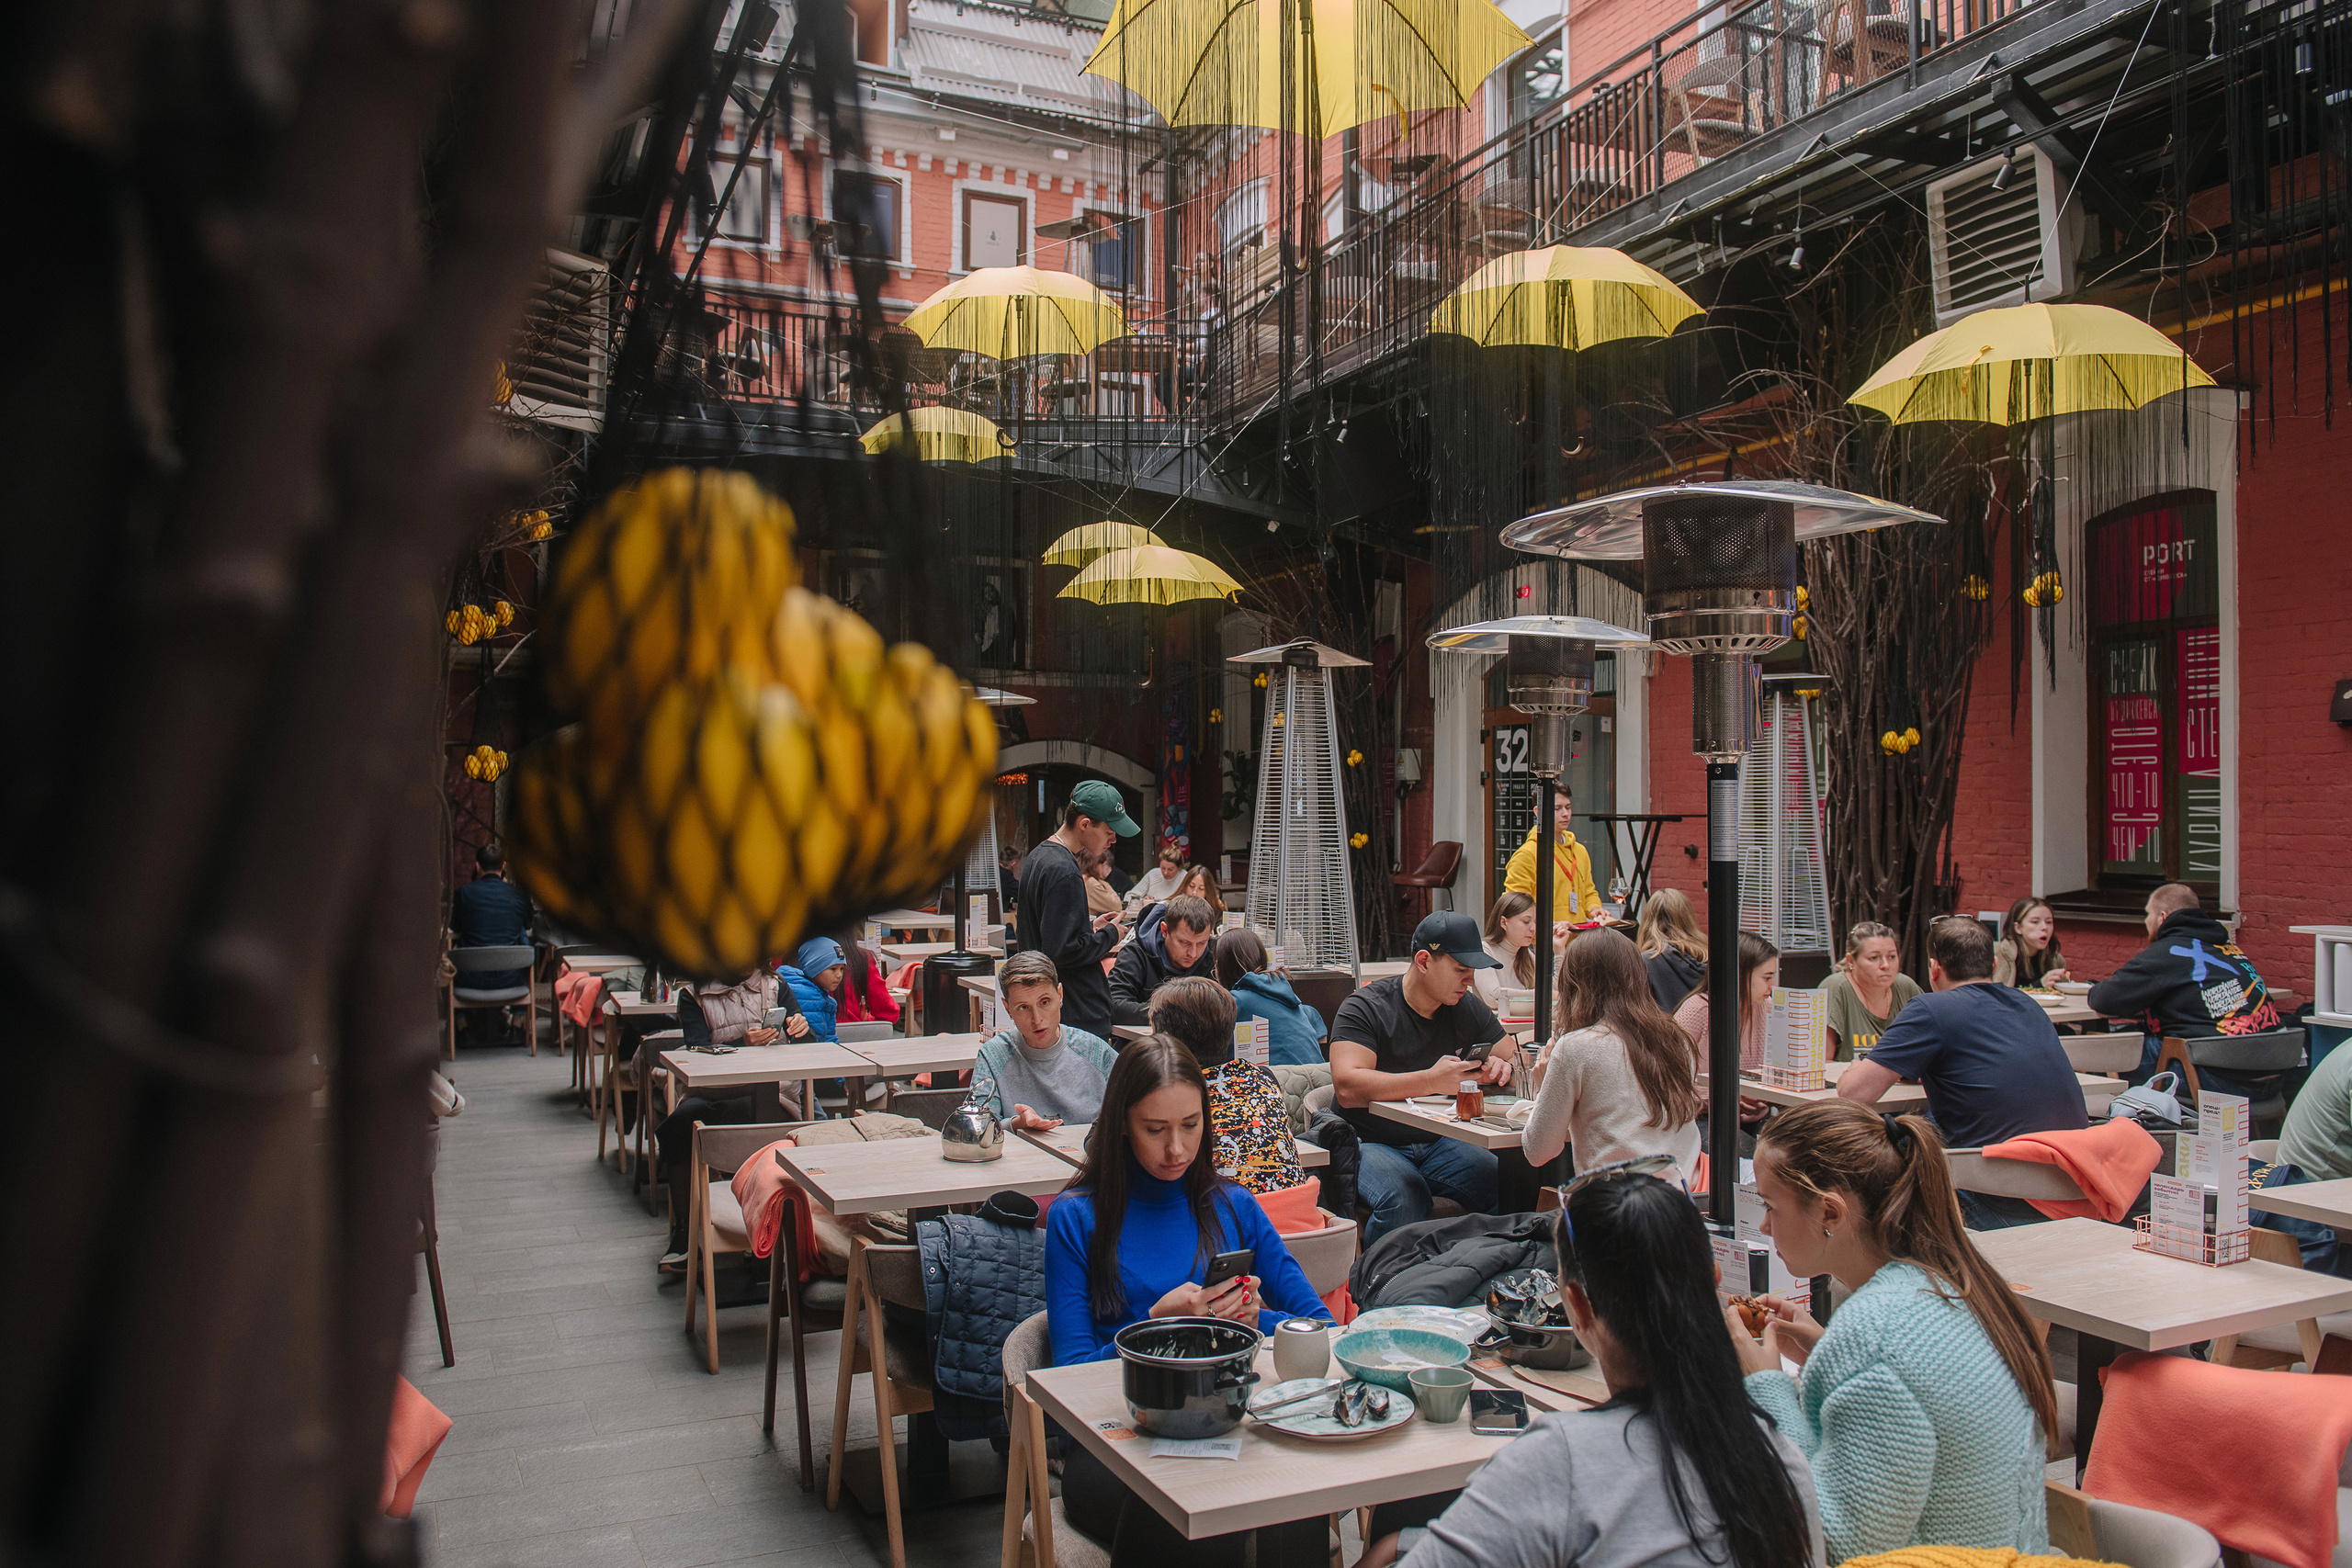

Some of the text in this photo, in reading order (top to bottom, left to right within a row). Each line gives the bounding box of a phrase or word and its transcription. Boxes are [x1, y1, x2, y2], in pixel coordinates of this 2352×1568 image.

[2143, 538, 2196, 567] PORT
[1495, 728, 1529, 773] 32
[2111, 772, 2158, 808] ЧТО-ТО
[2111, 813, 2159, 822] С
[2112, 826, 2160, 863] ЧЕМ-ТО
[2178, 1136, 2190, 1179] аки
